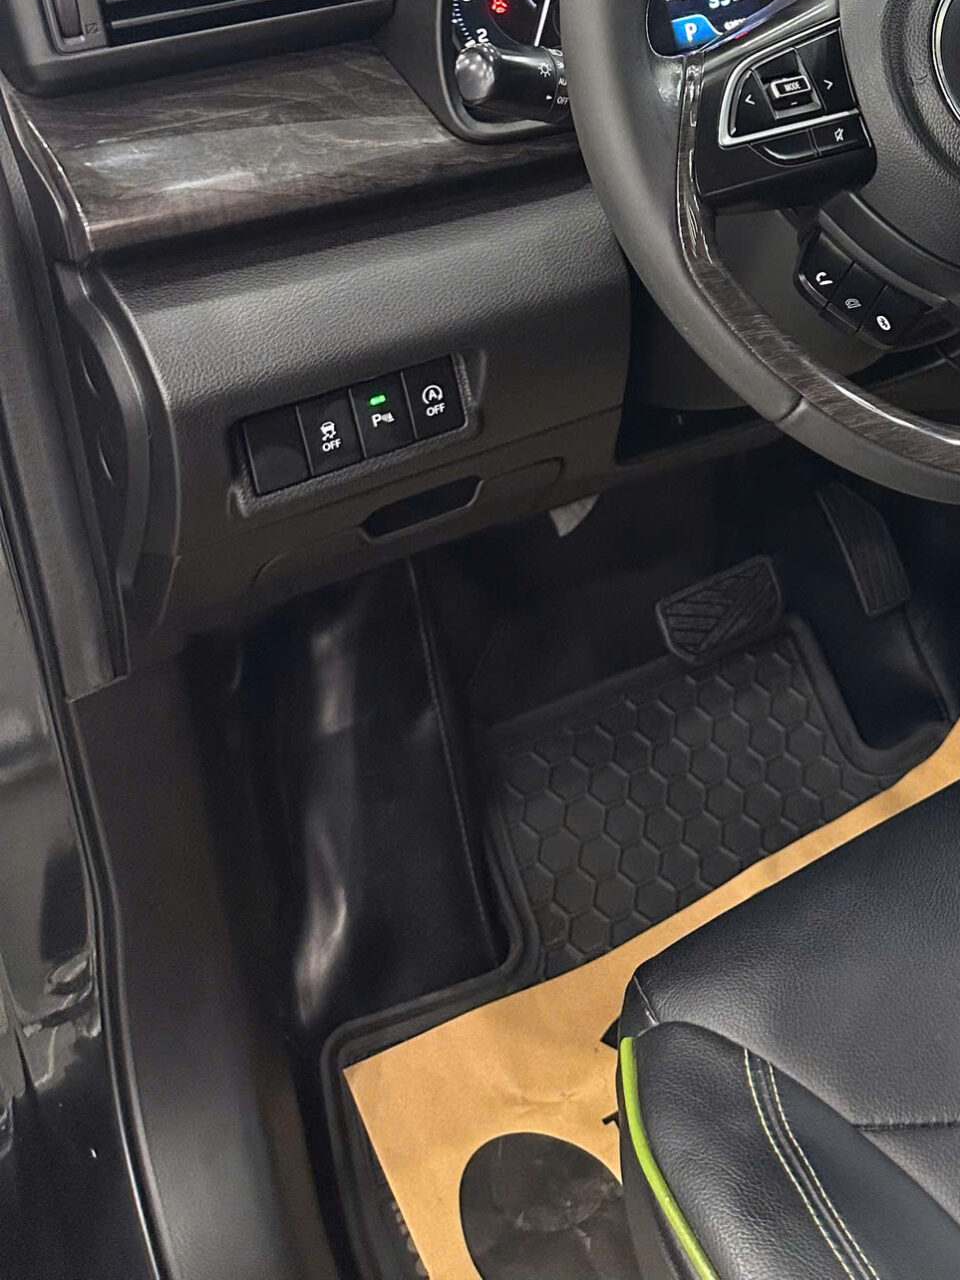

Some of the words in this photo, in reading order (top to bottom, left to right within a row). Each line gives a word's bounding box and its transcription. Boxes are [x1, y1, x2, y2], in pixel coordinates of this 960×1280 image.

[476, 28, 489, 43] 2
[685, 22, 698, 42] P
[783, 81, 801, 92] MODE
[426, 402, 446, 417] OFF
[321, 438, 342, 452] OFF
